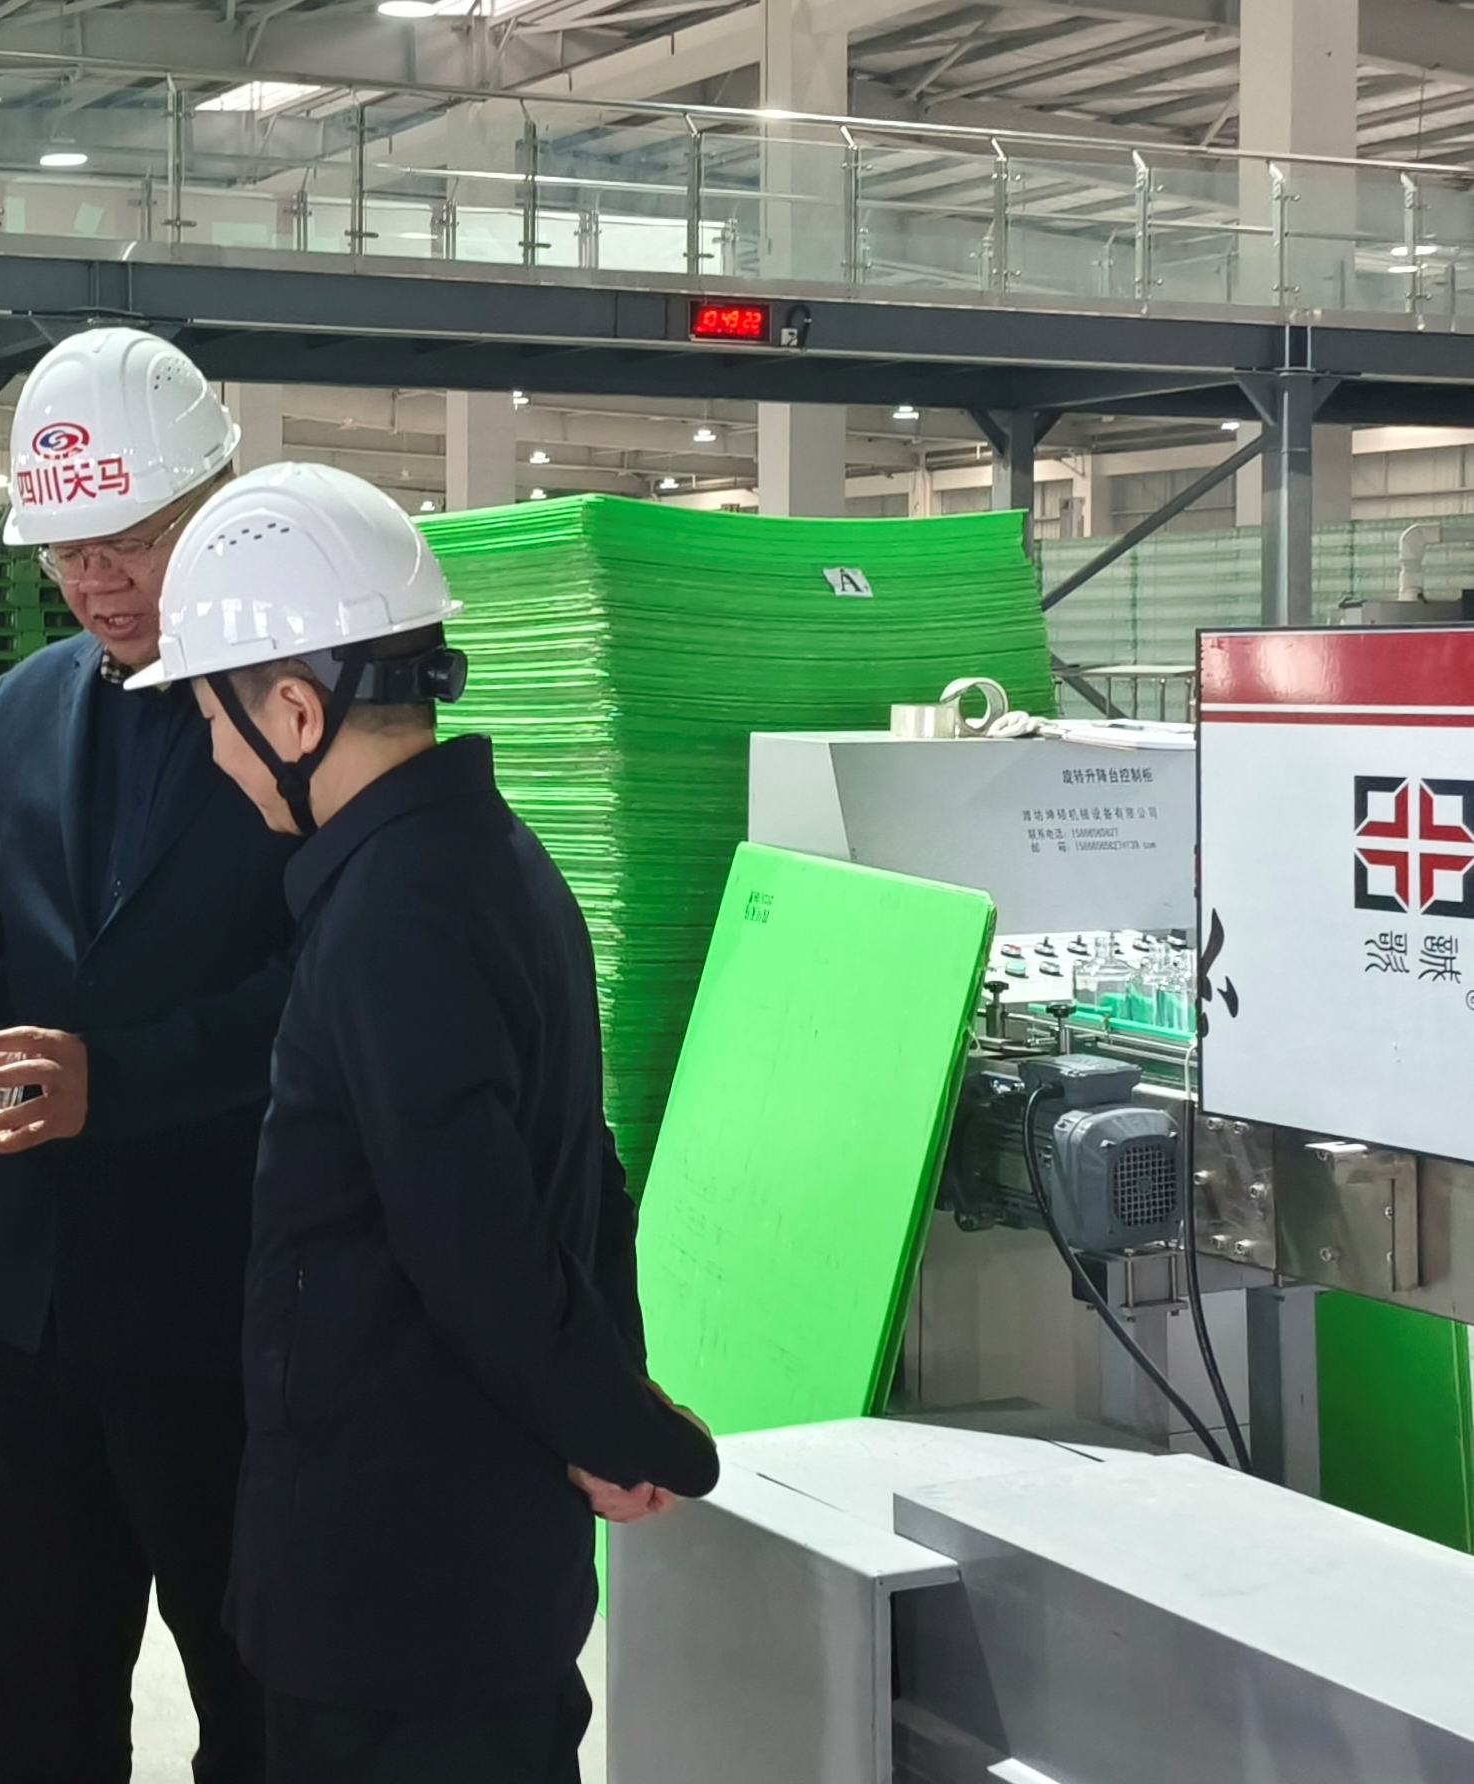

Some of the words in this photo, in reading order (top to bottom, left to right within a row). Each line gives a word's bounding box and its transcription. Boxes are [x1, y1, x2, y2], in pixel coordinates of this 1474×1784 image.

[17, 457, 130, 506] 四川天马
[839, 573, 864, 593] A
